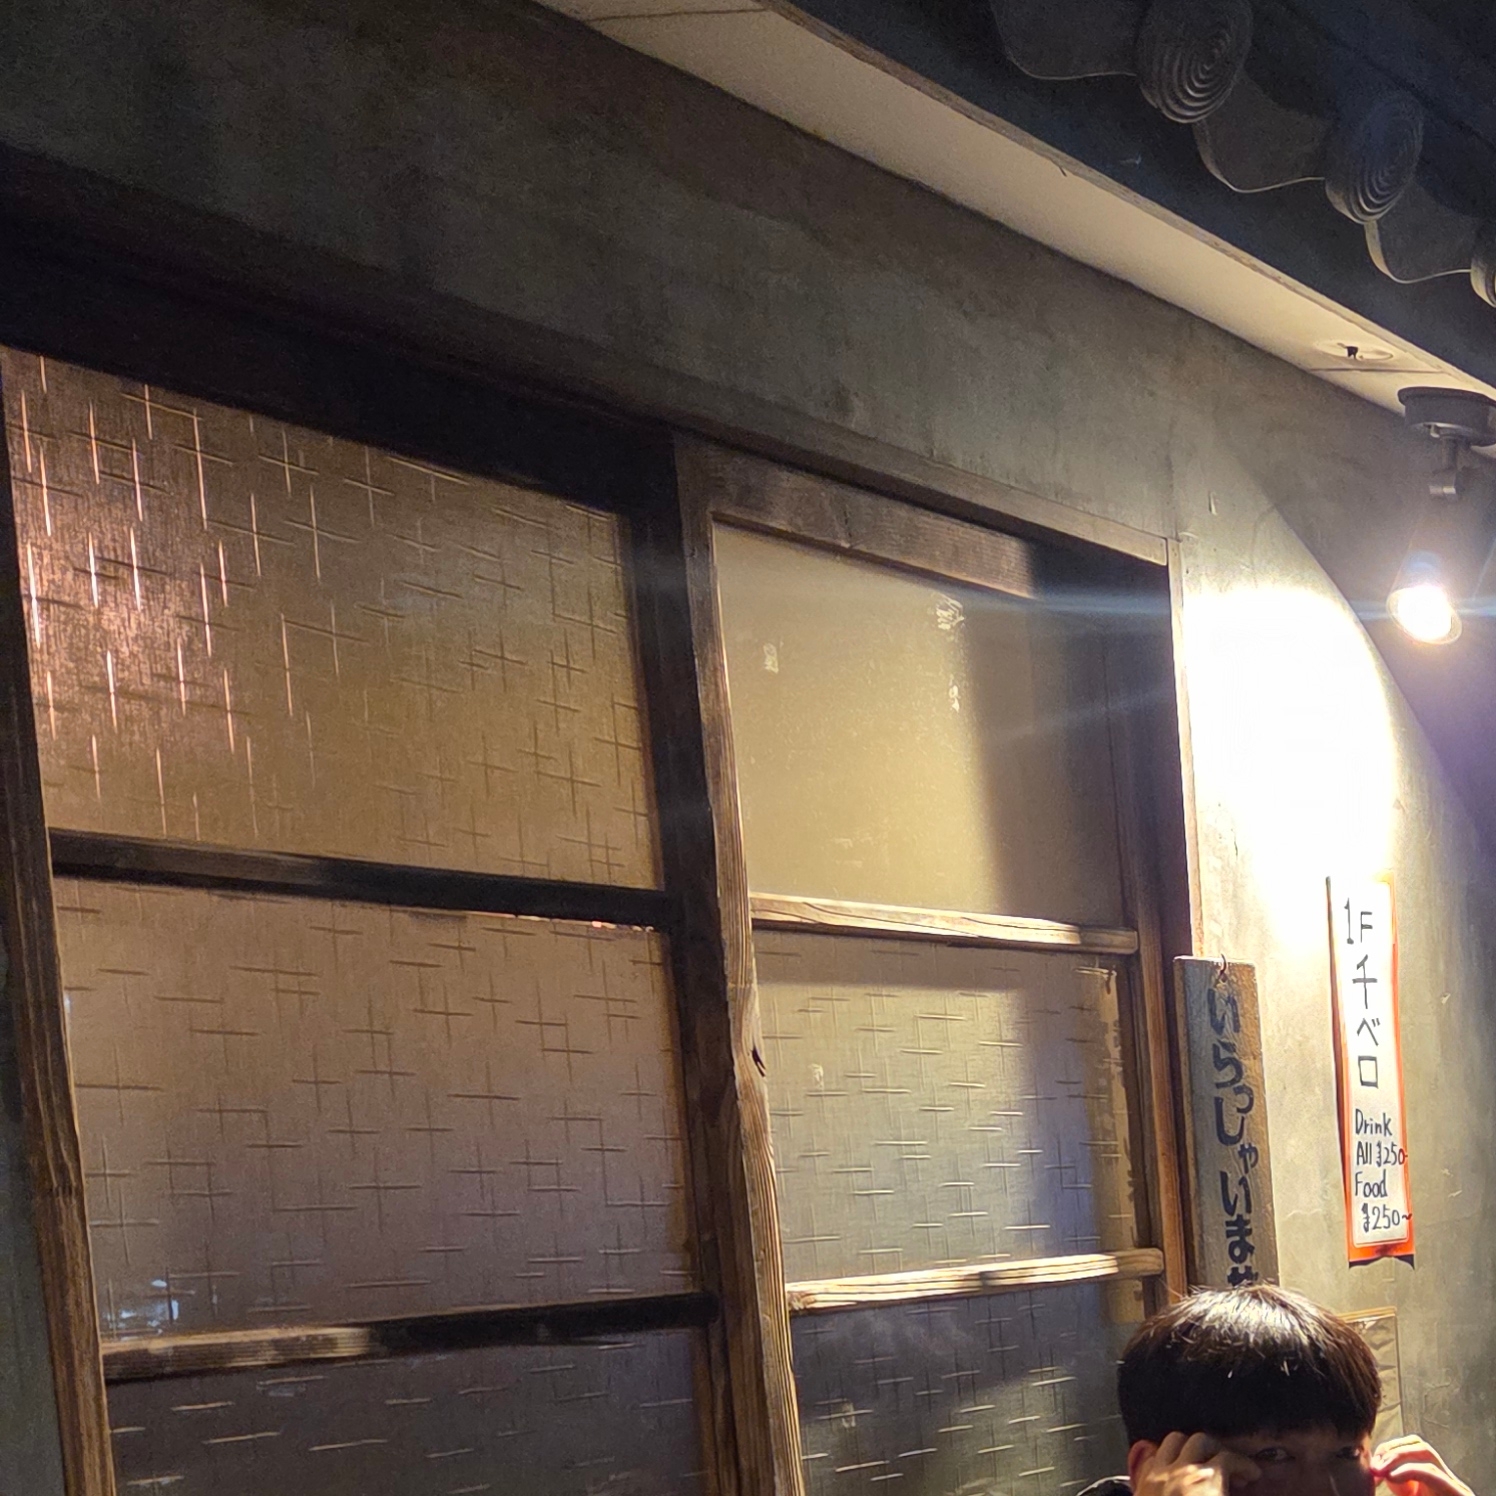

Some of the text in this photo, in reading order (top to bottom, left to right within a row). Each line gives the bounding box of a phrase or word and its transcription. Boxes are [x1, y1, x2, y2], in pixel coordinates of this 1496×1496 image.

[1355, 1108, 1392, 1136] Drink
[1356, 1141, 1372, 1165] All
[1355, 1169, 1388, 1197] Food
